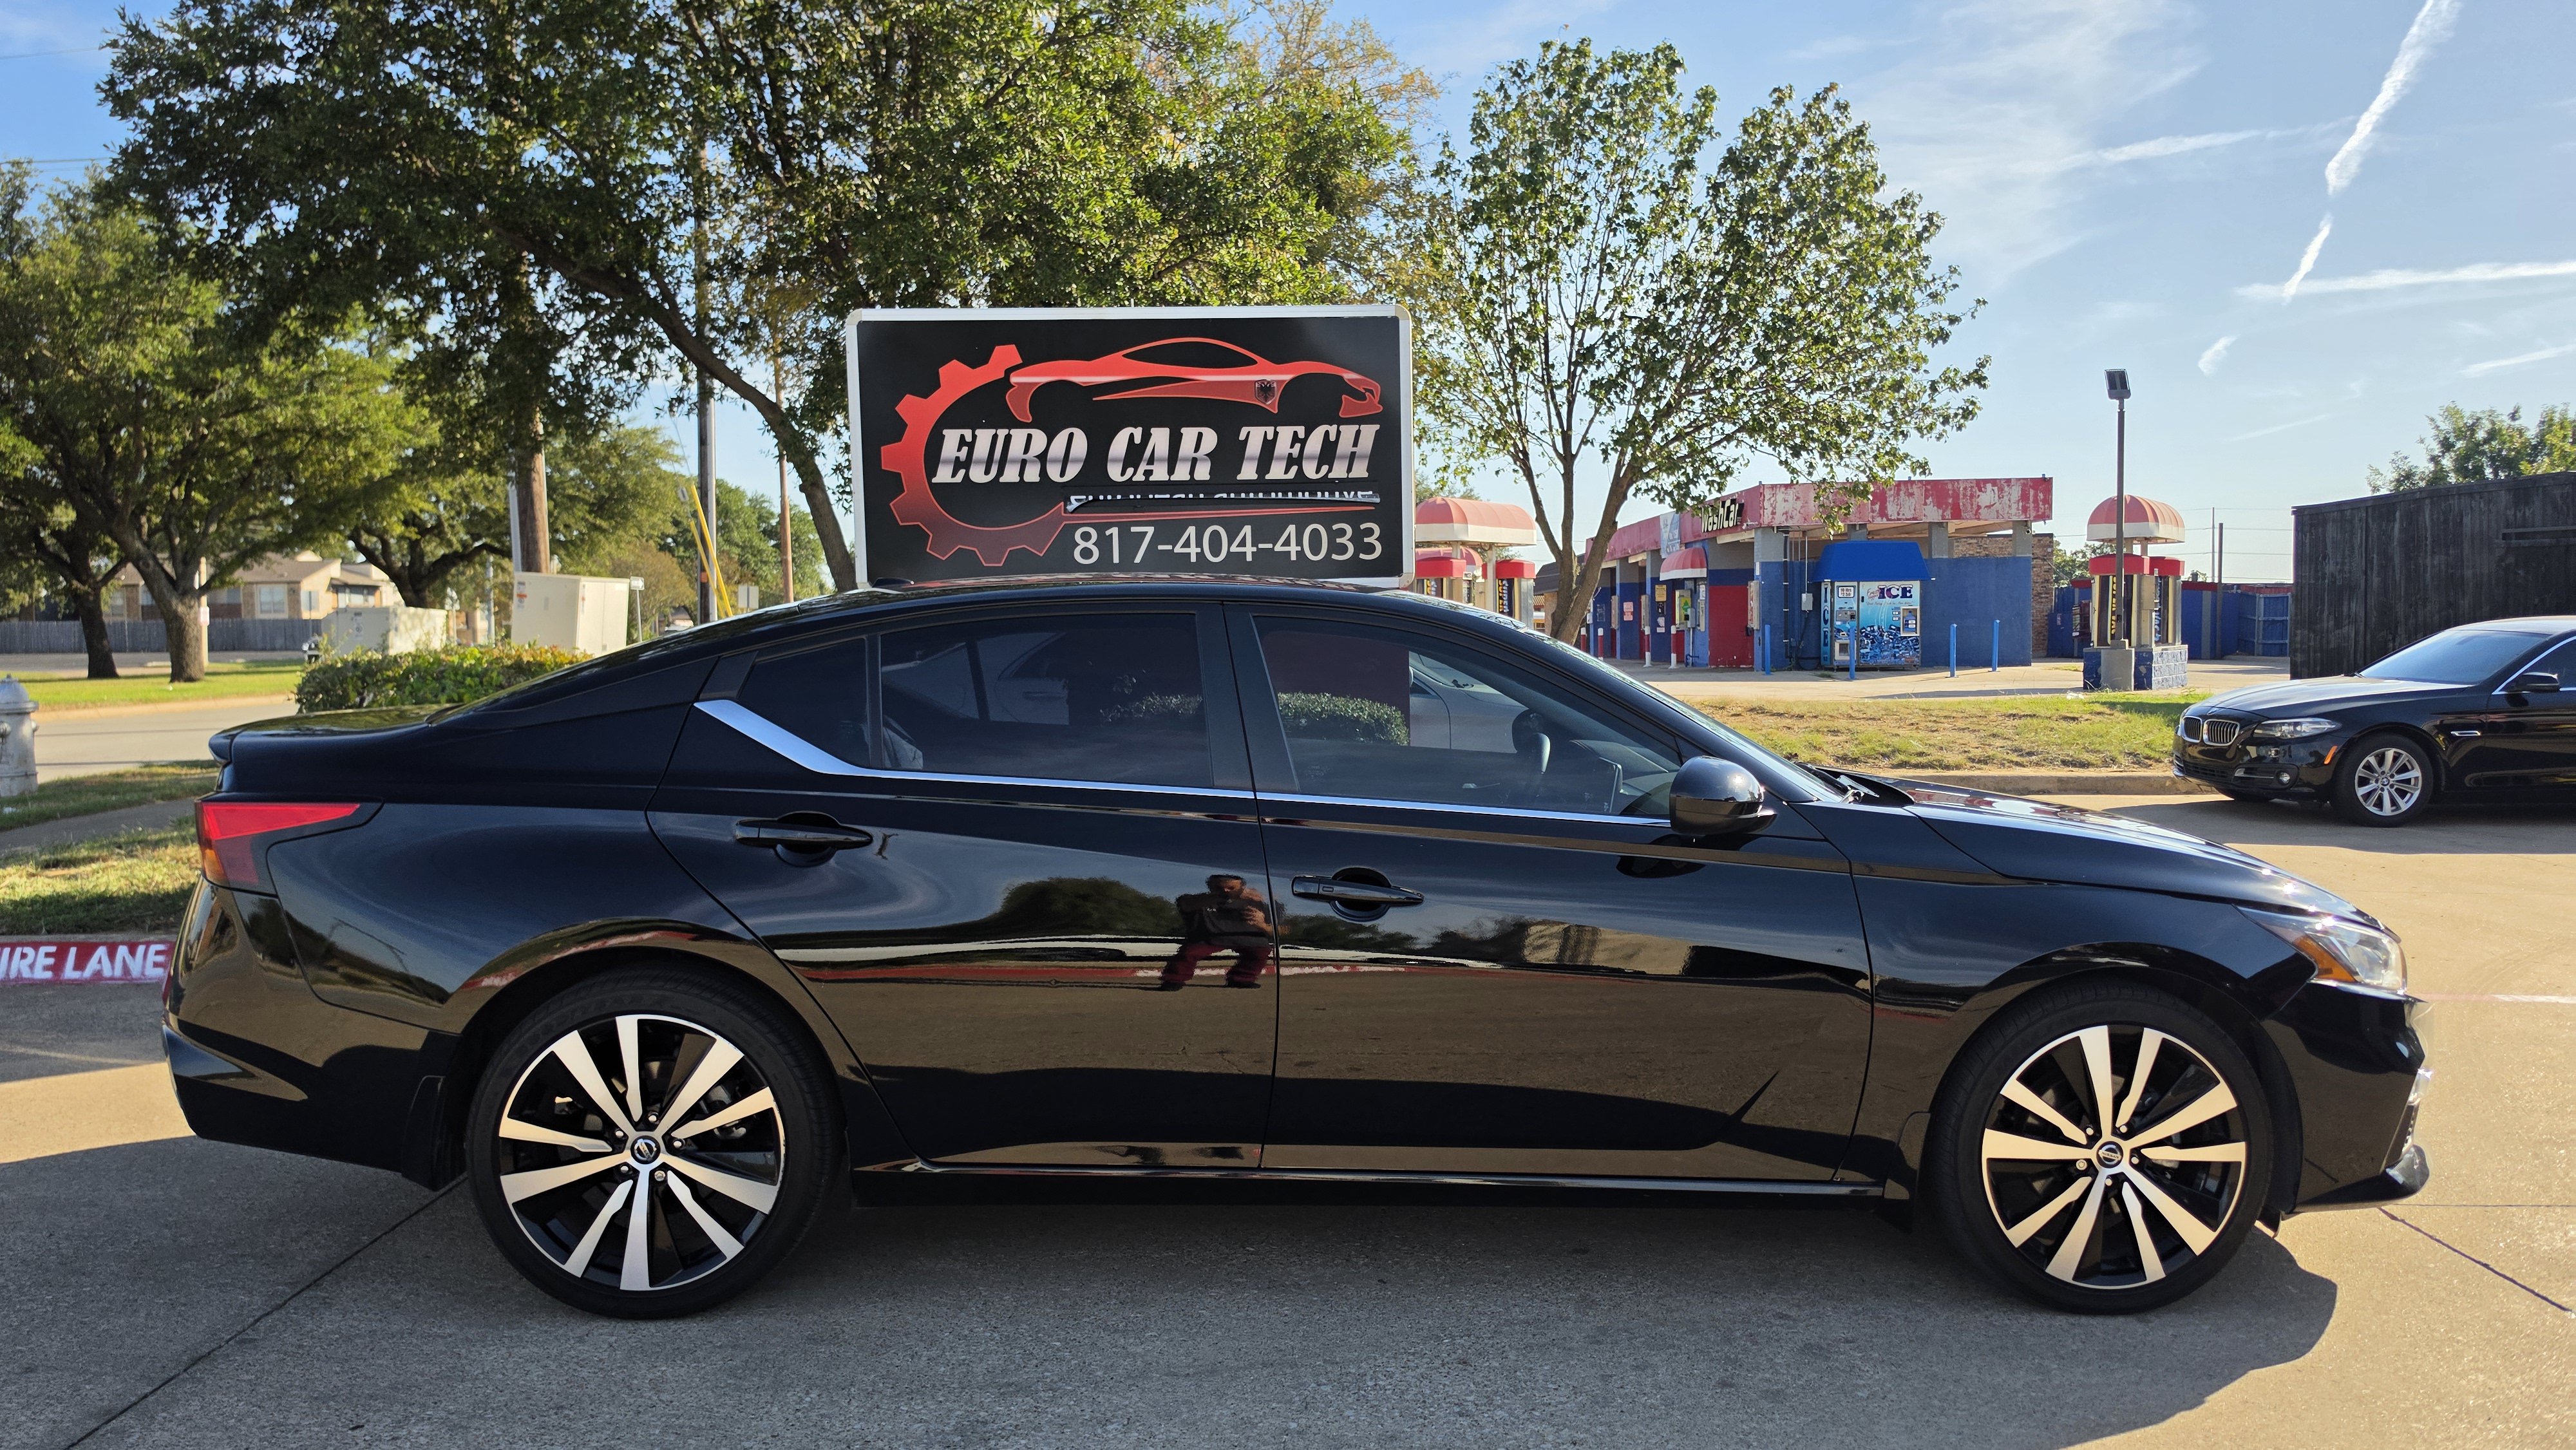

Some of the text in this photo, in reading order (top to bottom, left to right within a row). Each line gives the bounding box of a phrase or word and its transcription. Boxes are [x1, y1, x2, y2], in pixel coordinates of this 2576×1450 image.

[932, 424, 1381, 484] EURO CAR TECH
[1074, 522, 1382, 565] 817-404-4033
[1877, 584, 1913, 599] ICE
[63, 943, 169, 980] LANE
